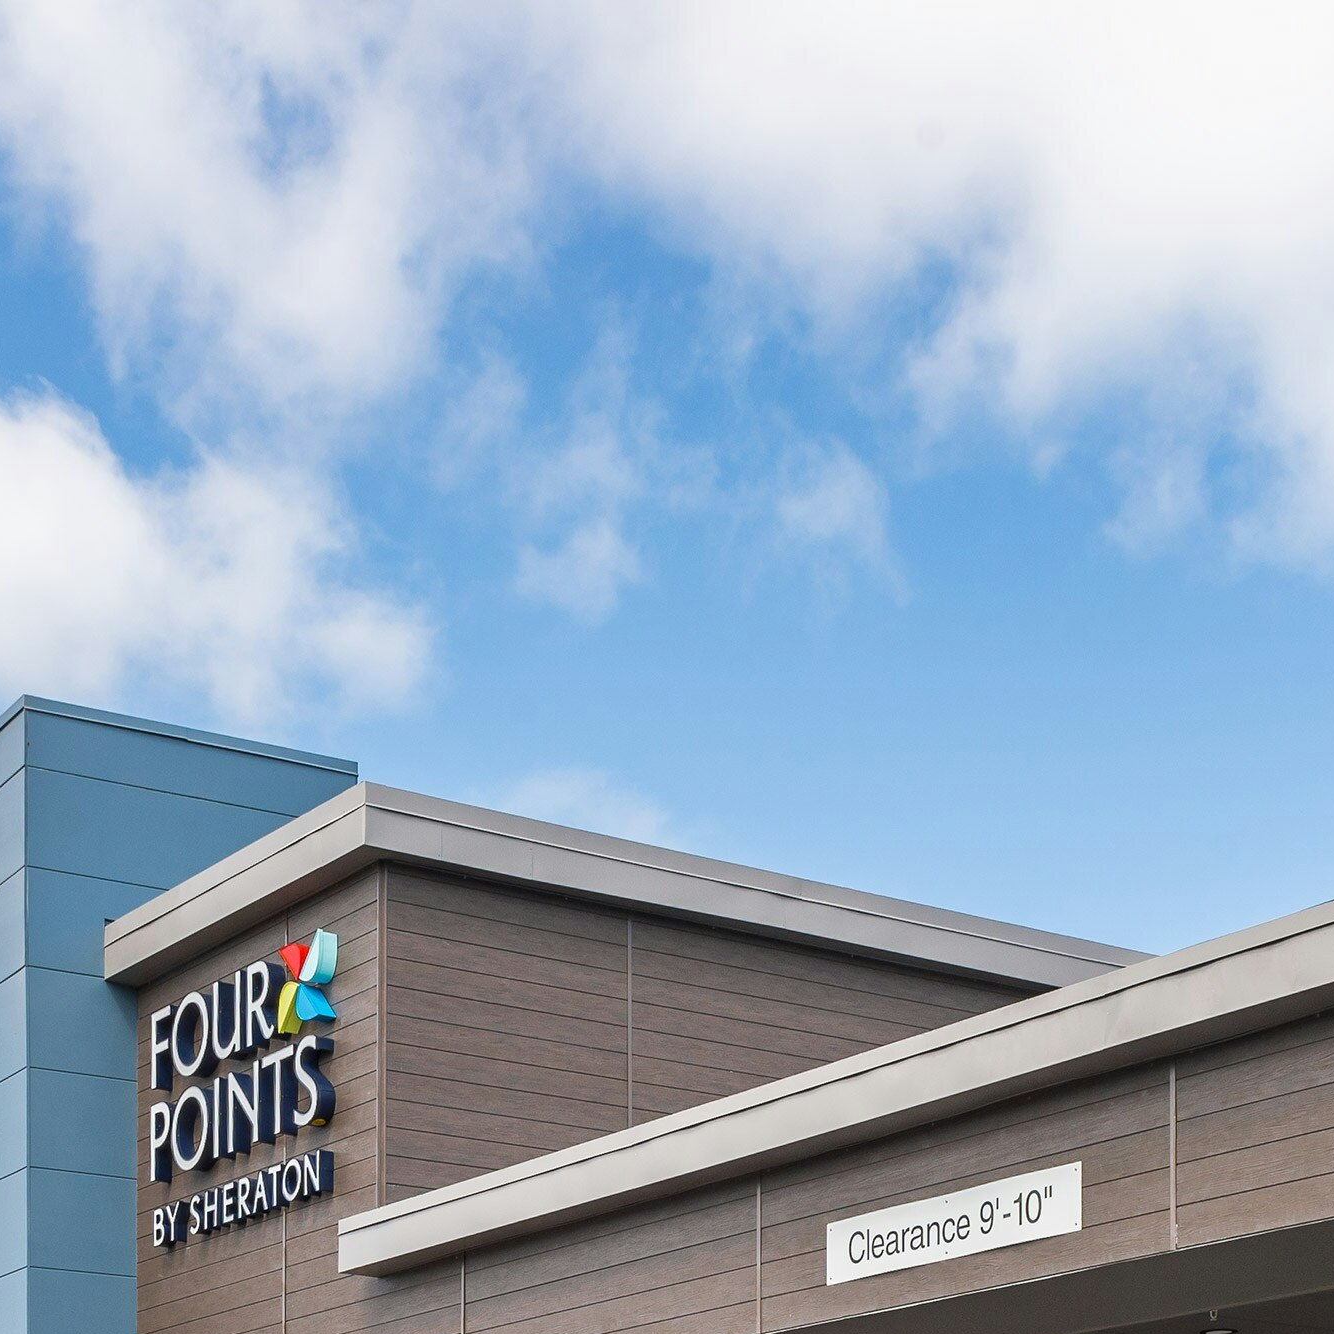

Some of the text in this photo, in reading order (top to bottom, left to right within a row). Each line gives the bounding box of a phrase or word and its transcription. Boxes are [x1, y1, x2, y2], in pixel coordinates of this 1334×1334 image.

[151, 961, 274, 1089] FOUR
[150, 1034, 318, 1182] POINTS
[153, 1150, 320, 1247] BY SHERATON
[848, 1185, 1053, 1264] Clearance 9'-10"
